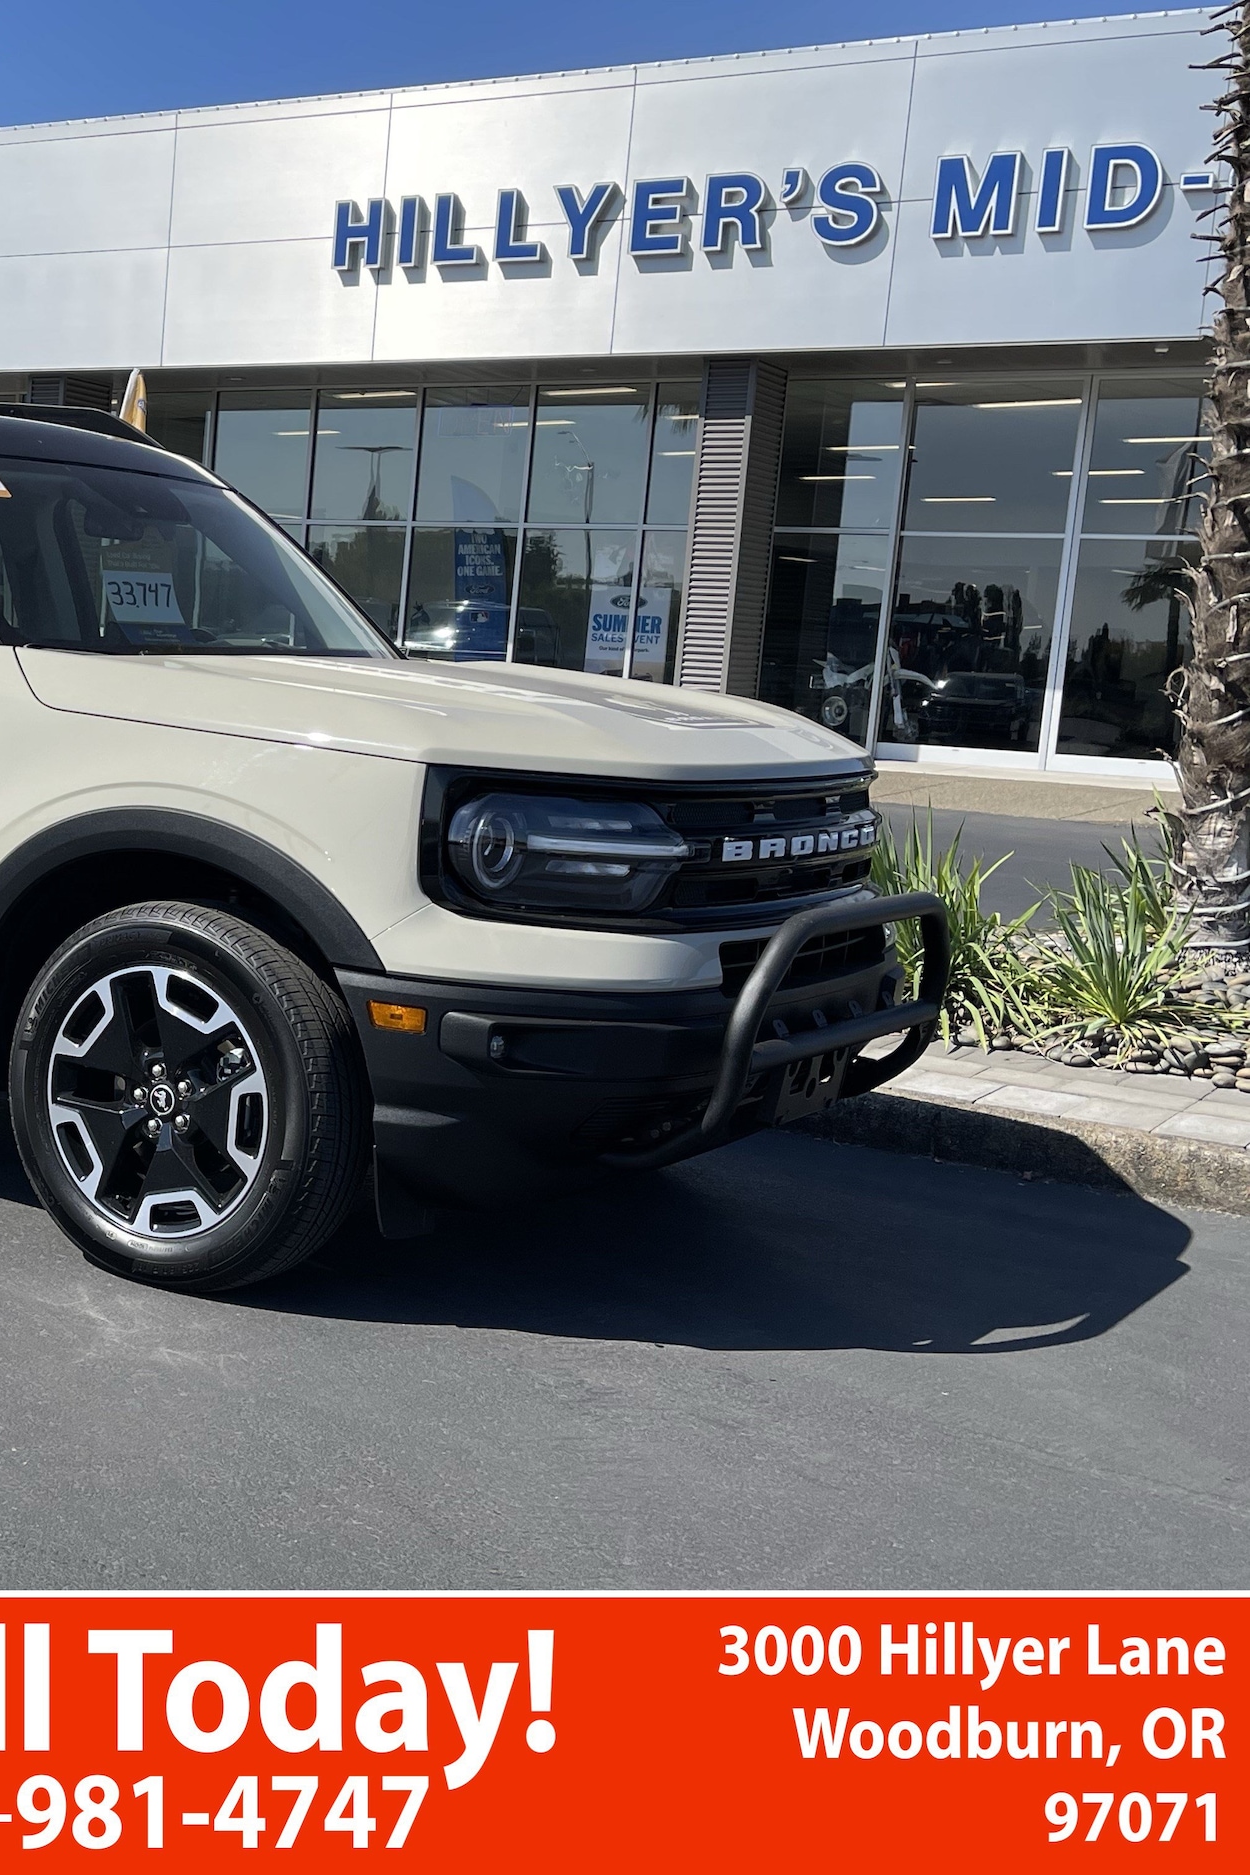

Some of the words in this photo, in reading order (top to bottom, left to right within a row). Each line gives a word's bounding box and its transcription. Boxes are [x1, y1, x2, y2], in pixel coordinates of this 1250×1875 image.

[331, 161, 881, 270] HILLYER'S
[457, 543, 501, 555] AMERICAN
[465, 554, 495, 566] ICONS.
[457, 565, 475, 577] ONE
[475, 565, 503, 577] GAME.
[592, 613, 663, 634] SUMER
[591, 632, 624, 643] SALES
[721, 825, 876, 862] BRONCO
